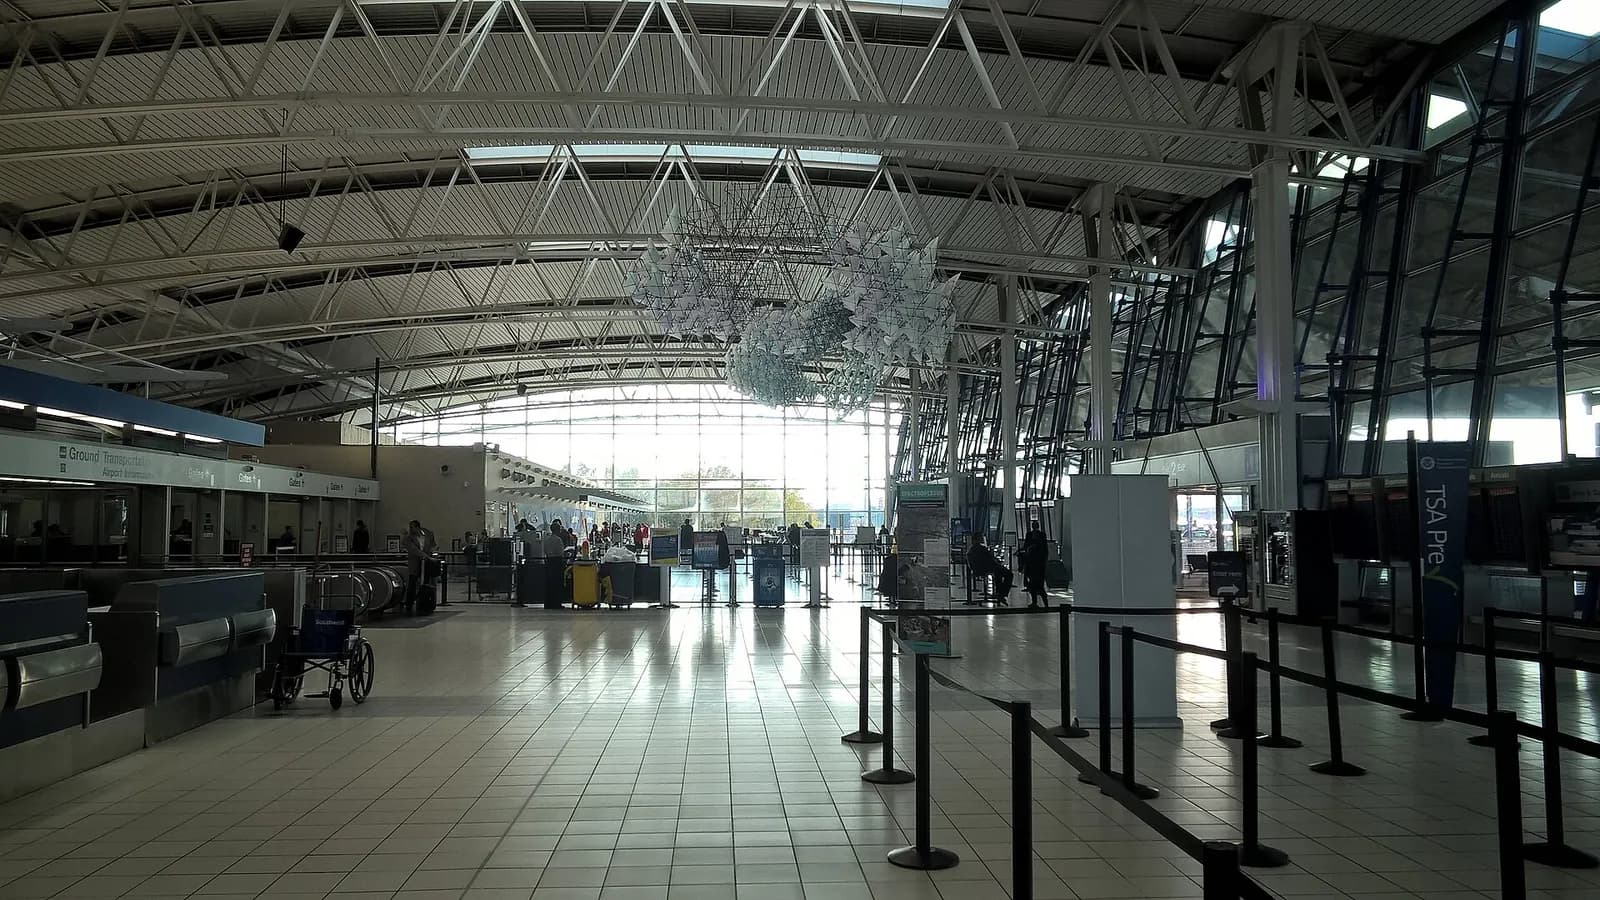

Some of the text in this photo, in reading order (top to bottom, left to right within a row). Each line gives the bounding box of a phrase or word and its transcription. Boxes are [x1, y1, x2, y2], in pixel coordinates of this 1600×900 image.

[69, 447, 99, 463] Ground
[1425, 484, 1448, 564] TSA Pre
